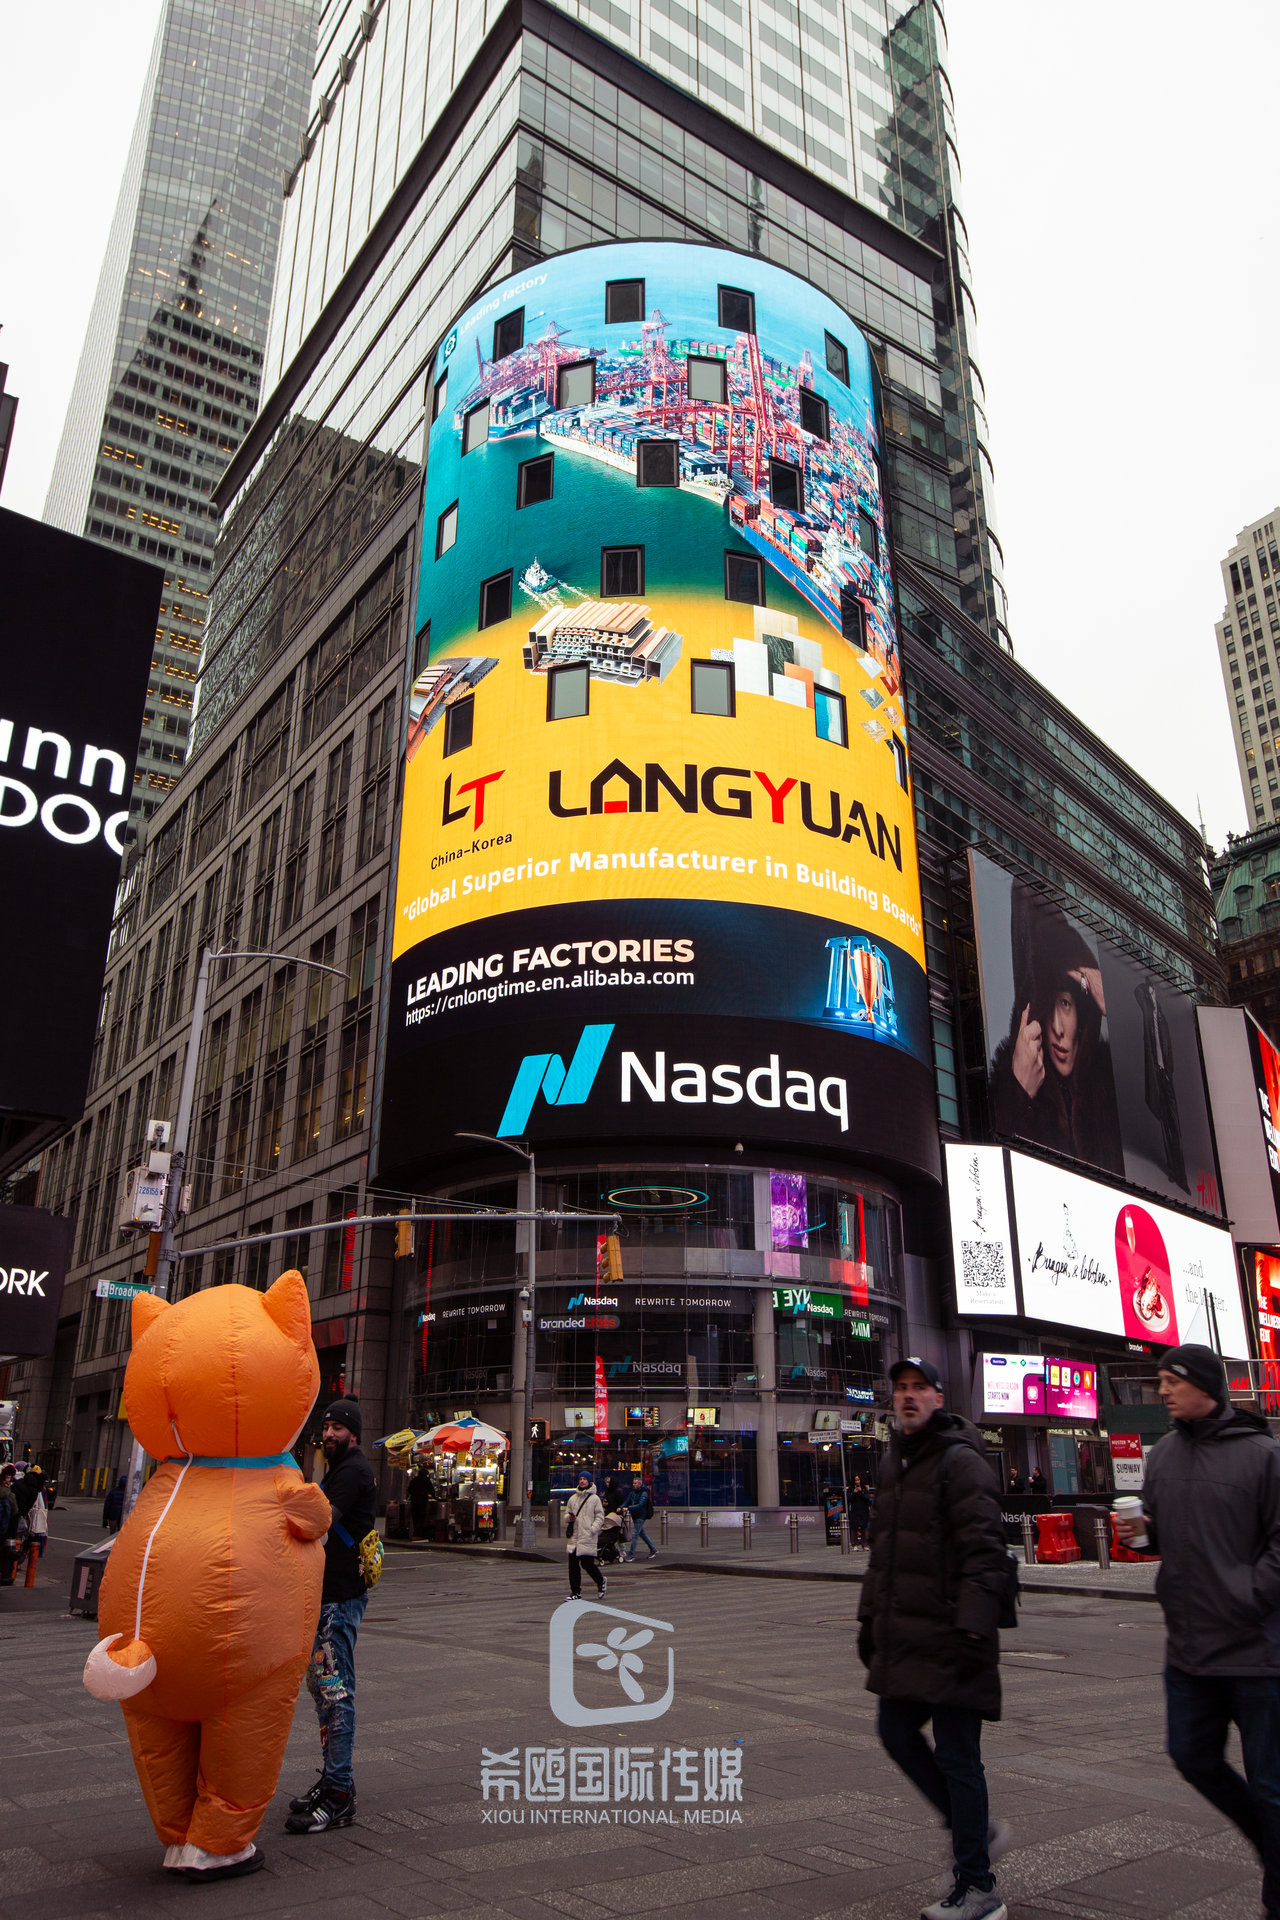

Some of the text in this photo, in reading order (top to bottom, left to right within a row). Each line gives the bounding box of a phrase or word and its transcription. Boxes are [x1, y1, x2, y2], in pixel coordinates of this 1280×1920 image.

[502, 272, 549, 303] factory
[548, 758, 903, 873] LANGYUAN
[430, 832, 513, 870] China-Korea
[462, 857, 561, 893] Superior
[569, 846, 758, 875] Manufacturer
[765, 856, 788, 880] in
[796, 863, 878, 911] Building
[406, 938, 695, 1006] LEADING FACTORIES
[405, 968, 695, 1027] https://cnlongtime.en.alibaba.com
[620, 1051, 850, 1133] Nasdaq
[583, 1296, 732, 1307] Nasdaq REWRITE TOMORROW
[806, 1303, 834, 1316] Nasdaq
[632, 1361, 682, 1376] Nasdaq
[1116, 1463, 1140, 1474] SUBWAY
